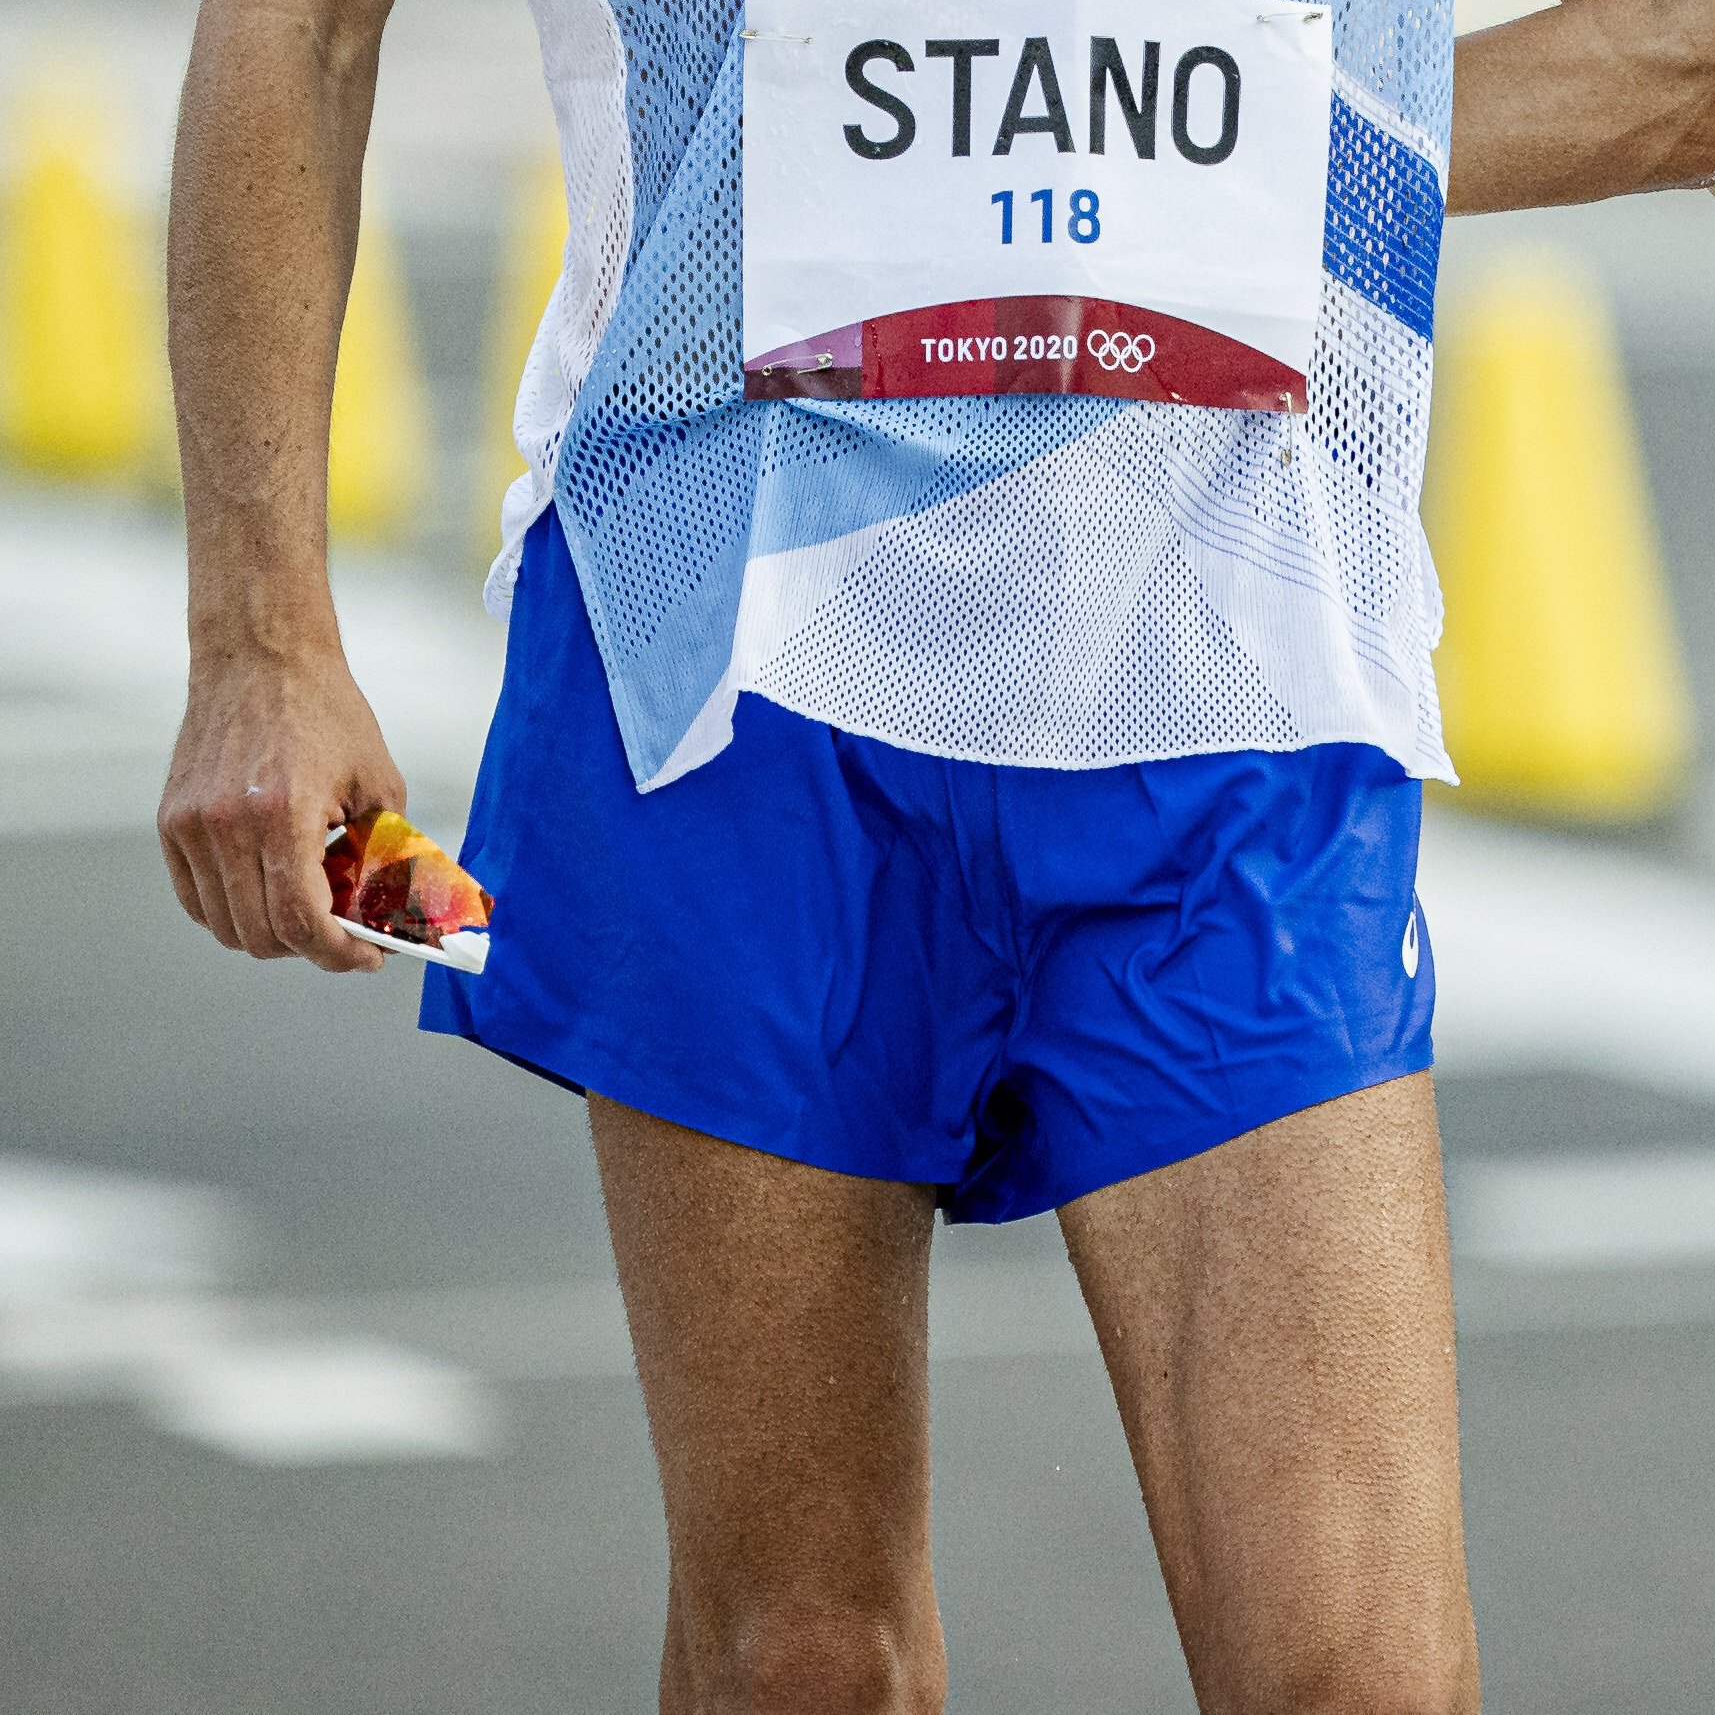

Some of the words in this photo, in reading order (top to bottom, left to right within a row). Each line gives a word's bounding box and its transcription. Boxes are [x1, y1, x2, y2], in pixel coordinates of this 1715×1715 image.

[842, 35, 1242, 166] STANO
[990, 188, 1102, 245] 118
[920, 335, 1007, 363] TOKYO
[1012, 333, 1079, 361] 2020
